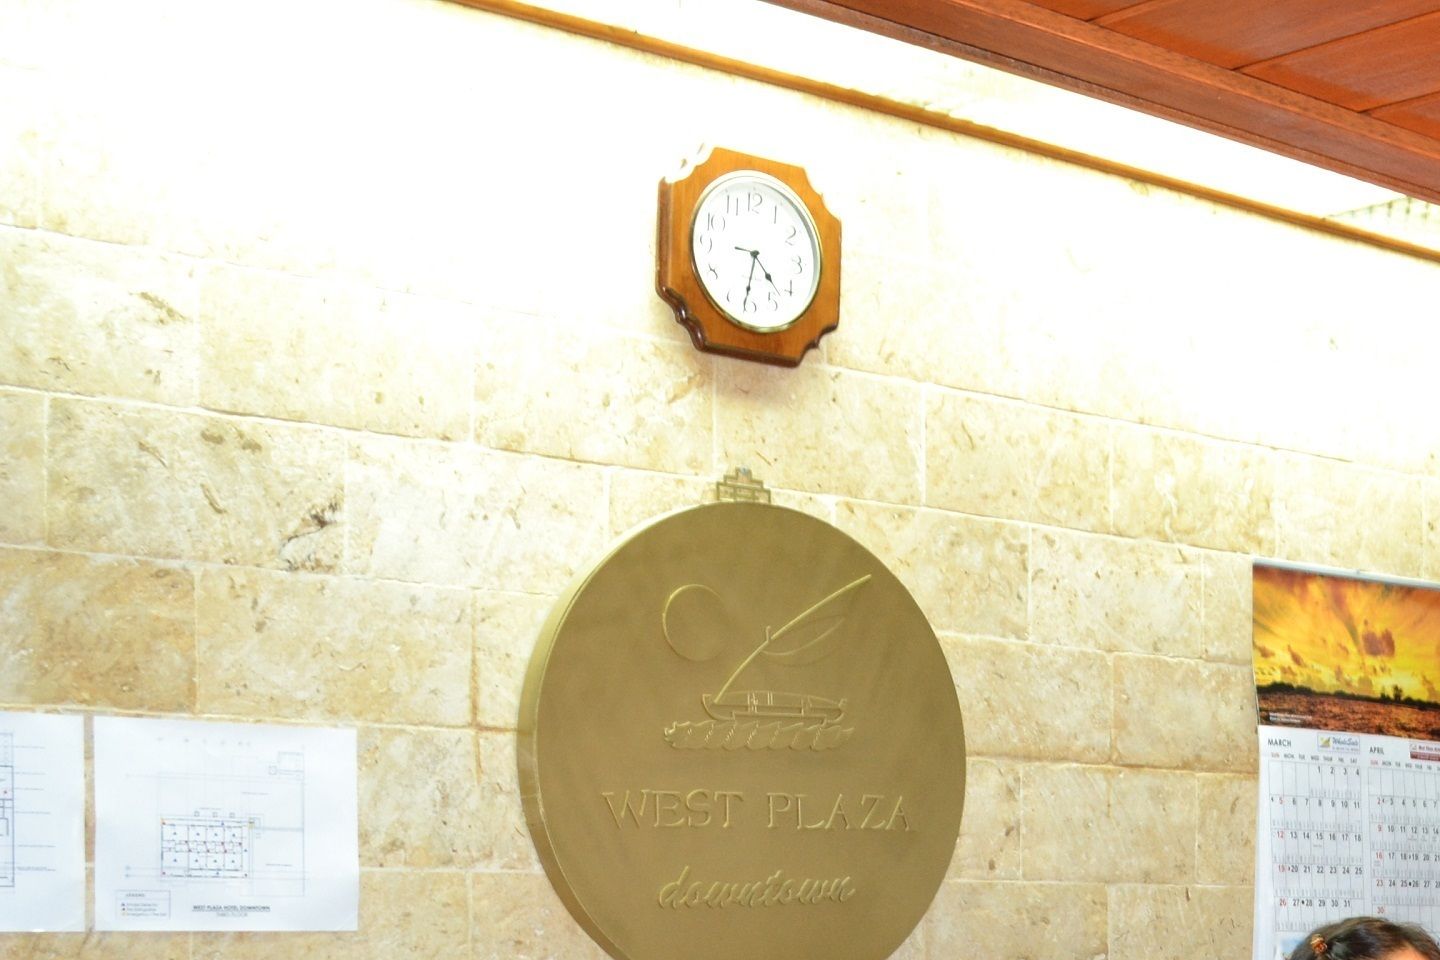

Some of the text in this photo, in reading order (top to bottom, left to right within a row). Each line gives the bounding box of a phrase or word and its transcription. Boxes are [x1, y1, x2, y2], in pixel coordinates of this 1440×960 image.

[726, 195, 738, 216] 11
[747, 193, 762, 214] 12
[707, 212, 725, 231] 10
[785, 226, 796, 246] 2
[792, 256, 802, 274] 3
[1268, 738, 1291, 747] MARCH
[1369, 746, 1384, 755] APRIL
[601, 789, 911, 832] WEST PLAZA
[1277, 831, 1284, 839] 12
[1290, 831, 1297, 839] 13
[1342, 833, 1348, 841] 17
[1291, 865, 1298, 873] 20
[1303, 865, 1311, 873] 21
[1329, 866, 1337, 874] 23
[1355, 867, 1362, 875] 25
[658, 865, 857, 910] downtown
[1280, 899, 1286, 907] 26
[1293, 899, 1299, 907] 27
[1306, 899, 1312, 907] 28
[1318, 899, 1325, 907] 29
